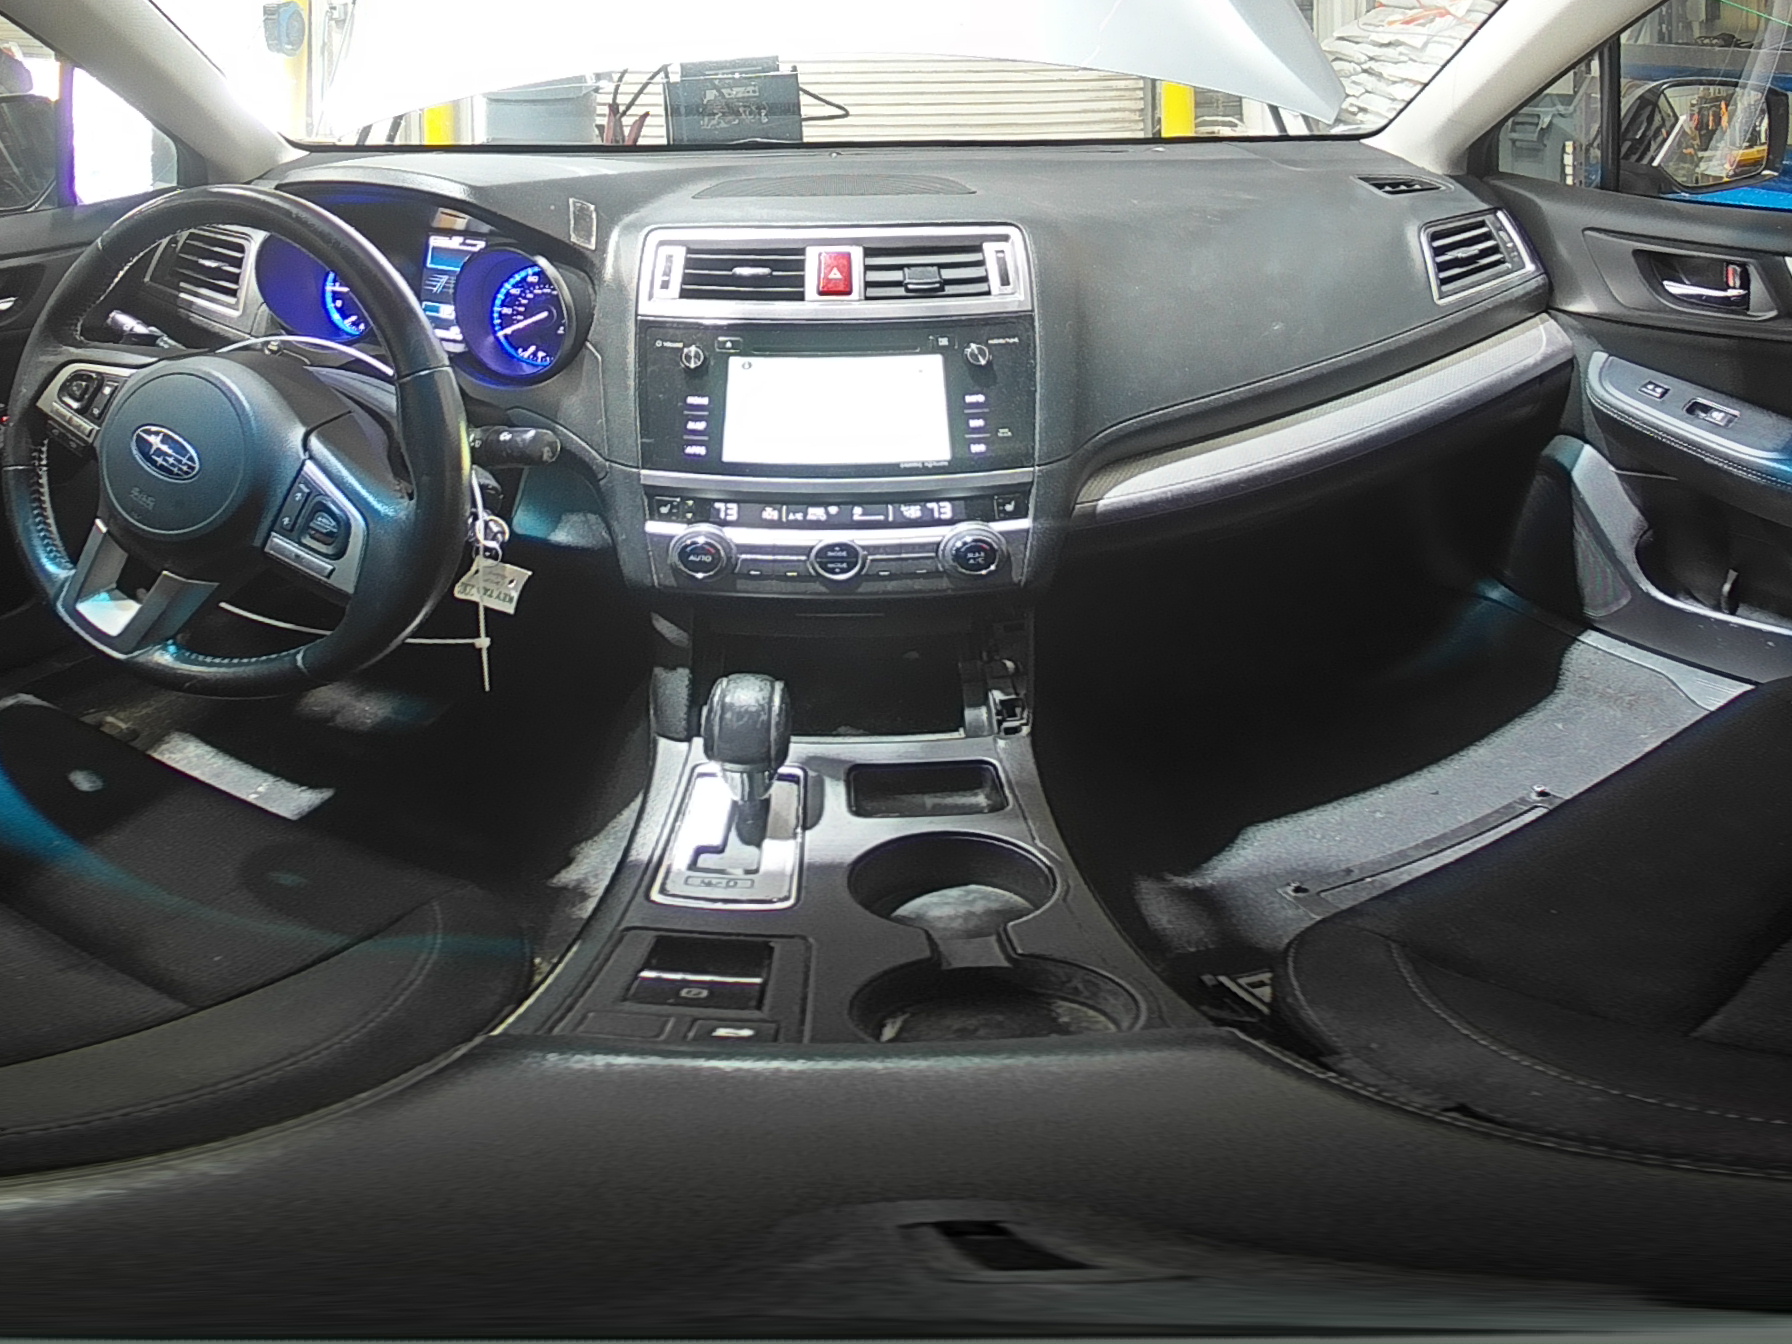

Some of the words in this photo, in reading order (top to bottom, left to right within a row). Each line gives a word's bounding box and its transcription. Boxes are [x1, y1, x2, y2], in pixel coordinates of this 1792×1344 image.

[713, 501, 739, 521] 73
[925, 501, 953, 519] 73
[688, 554, 712, 563] AUTO
[495, 590, 515, 605] KEY
